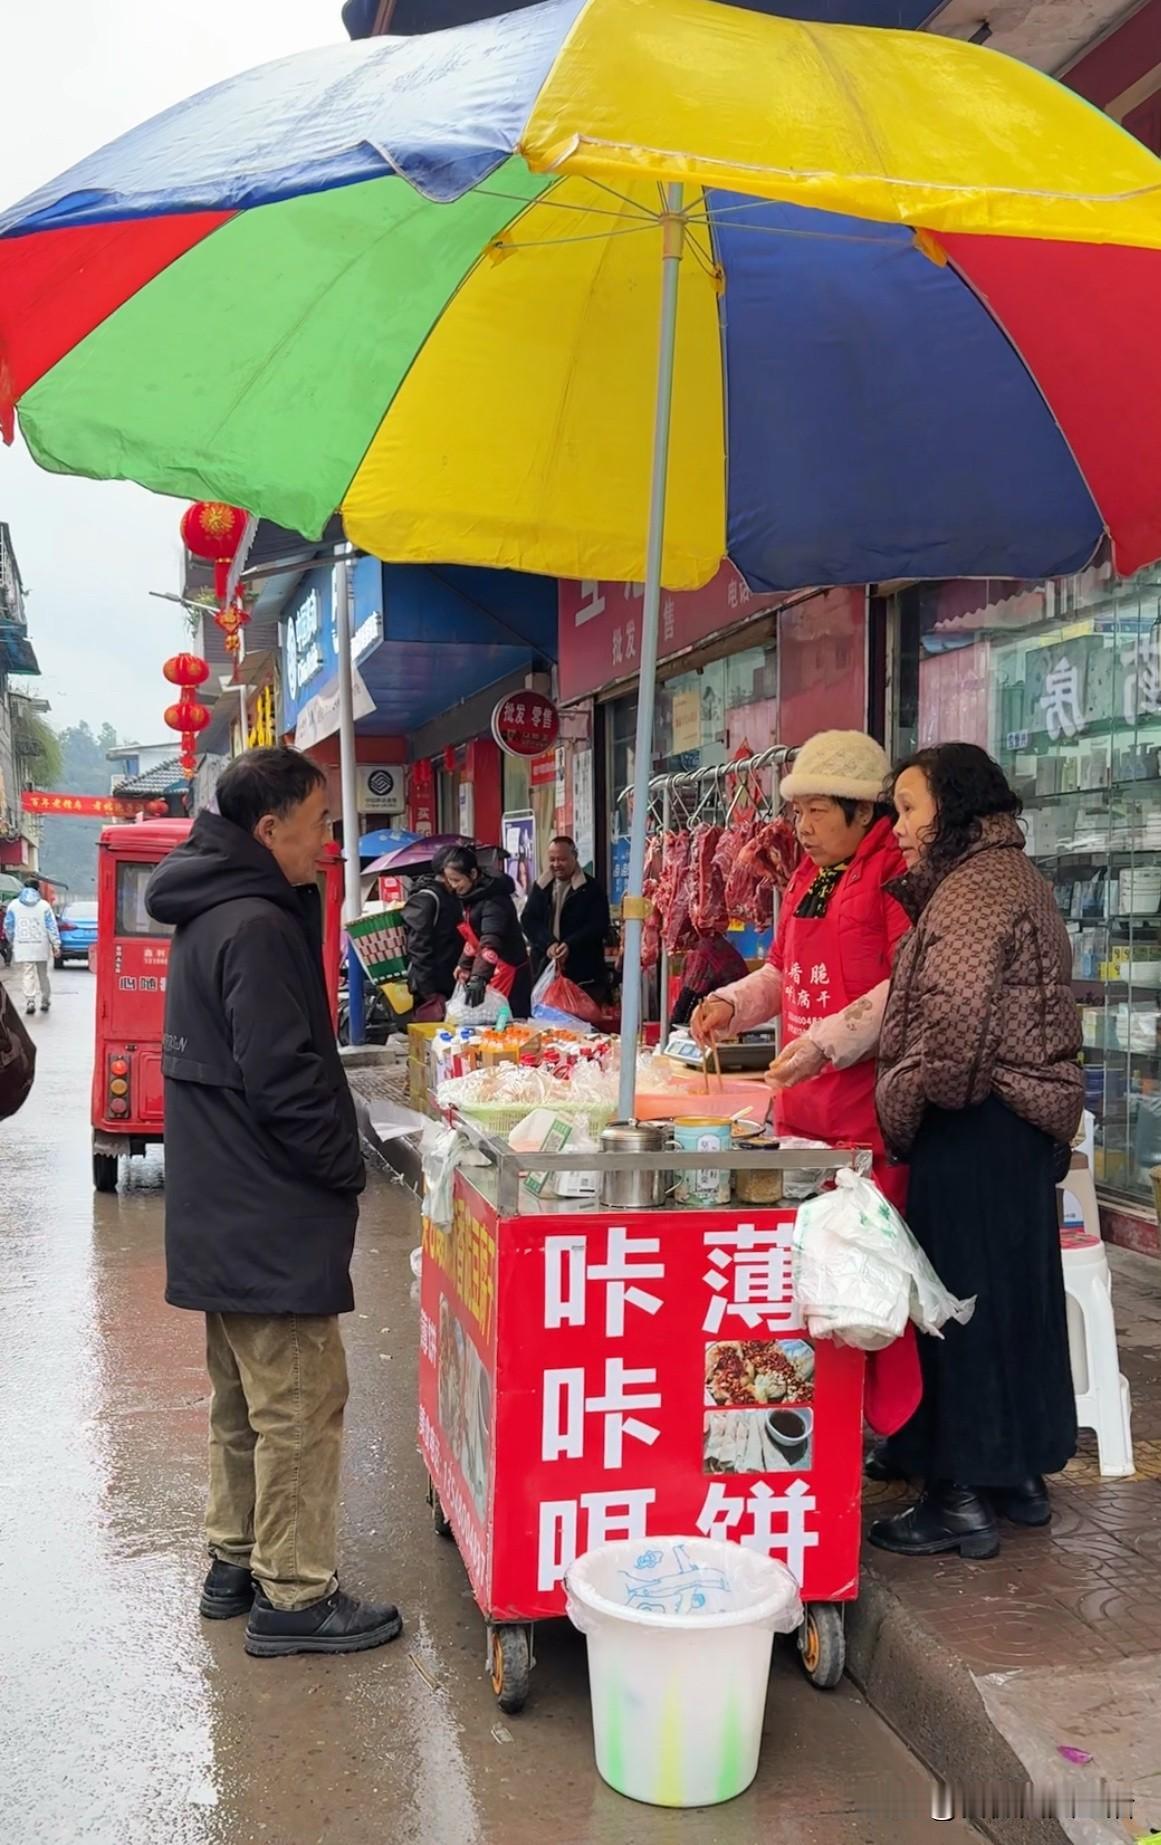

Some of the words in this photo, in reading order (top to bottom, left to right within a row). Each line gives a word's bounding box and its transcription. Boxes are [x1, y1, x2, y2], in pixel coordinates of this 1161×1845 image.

[612, 621, 637, 666] 批发
[503, 702, 526, 725] 批发
[531, 706, 553, 729] 零售
